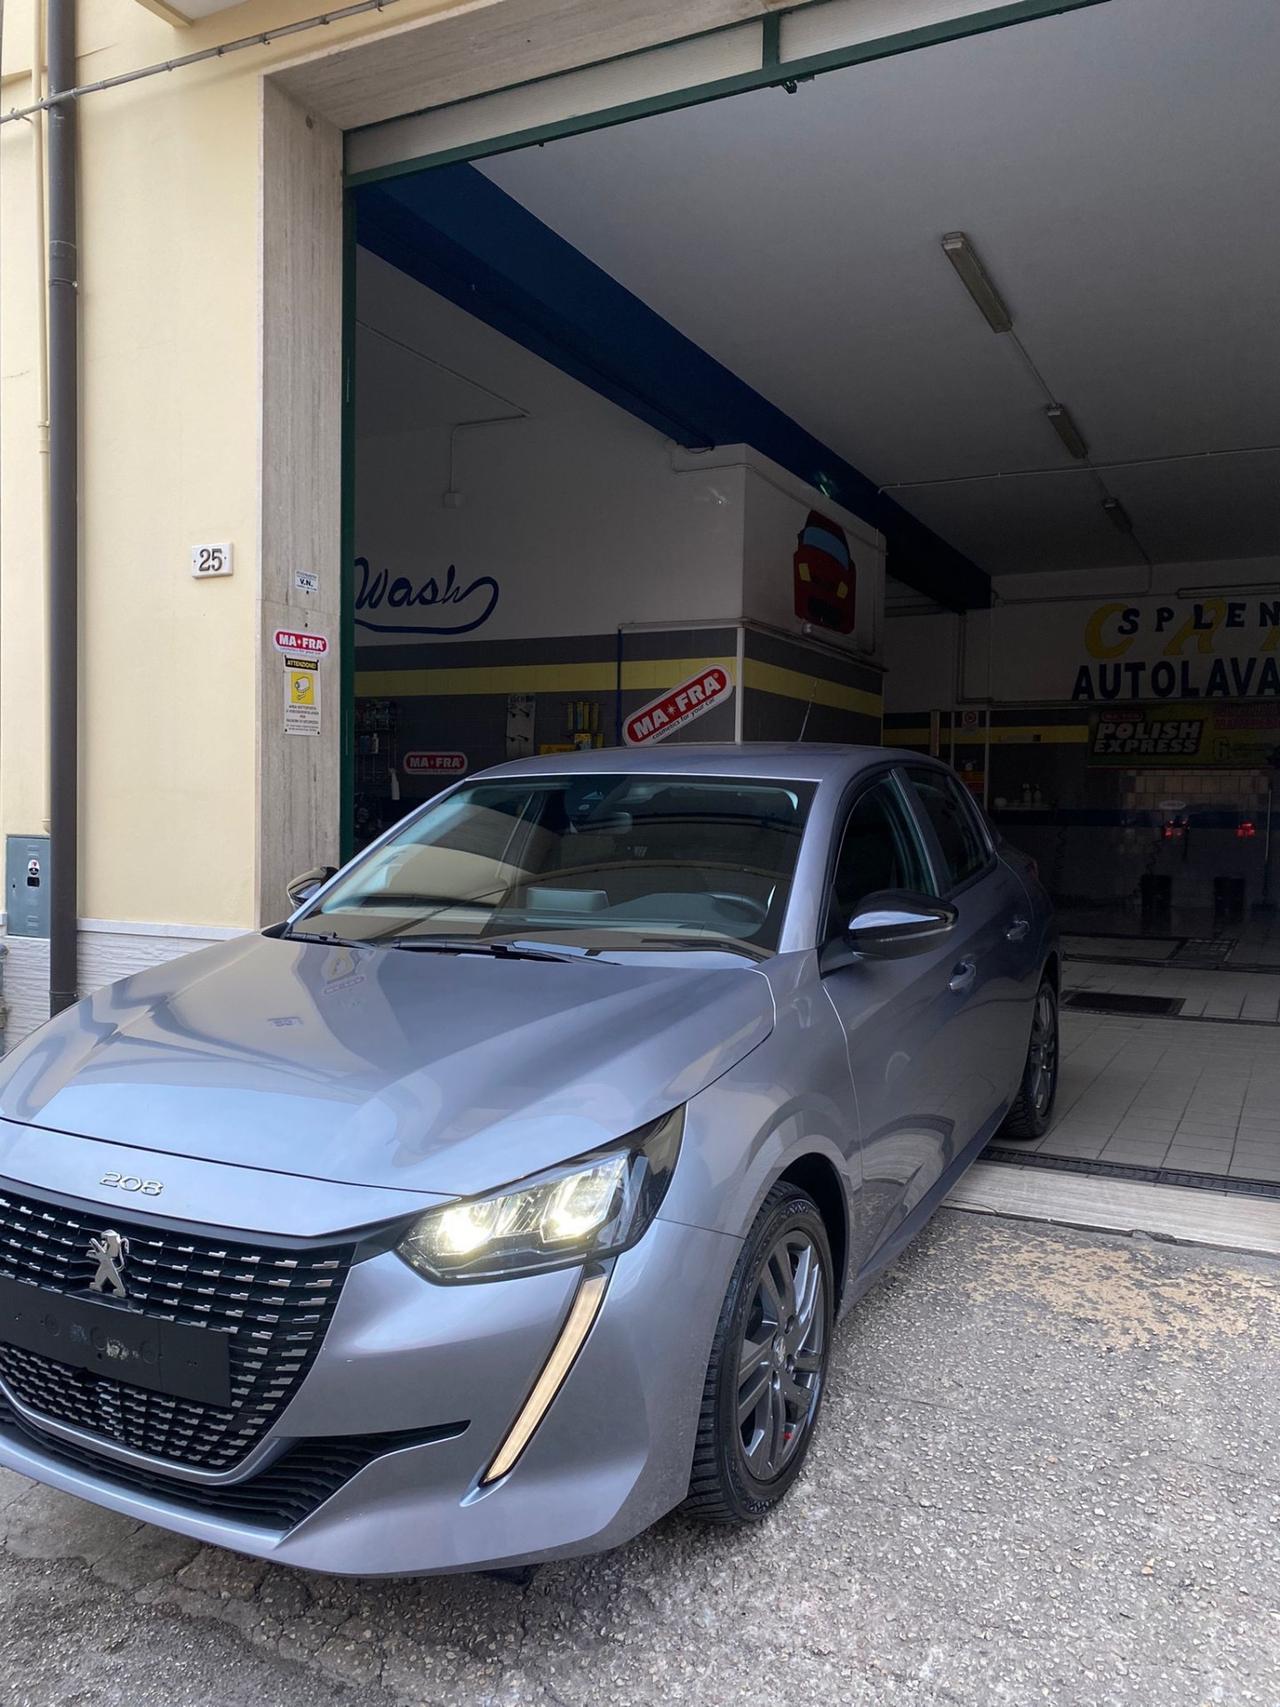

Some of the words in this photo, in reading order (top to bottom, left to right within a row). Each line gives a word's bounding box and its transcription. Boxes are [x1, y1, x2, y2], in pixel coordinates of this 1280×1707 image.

[199, 548, 223, 572] 25
[1097, 720, 1201, 739] POLISH
[1093, 739, 1198, 754] EXPRESS
[100, 1171, 164, 1196] 208
